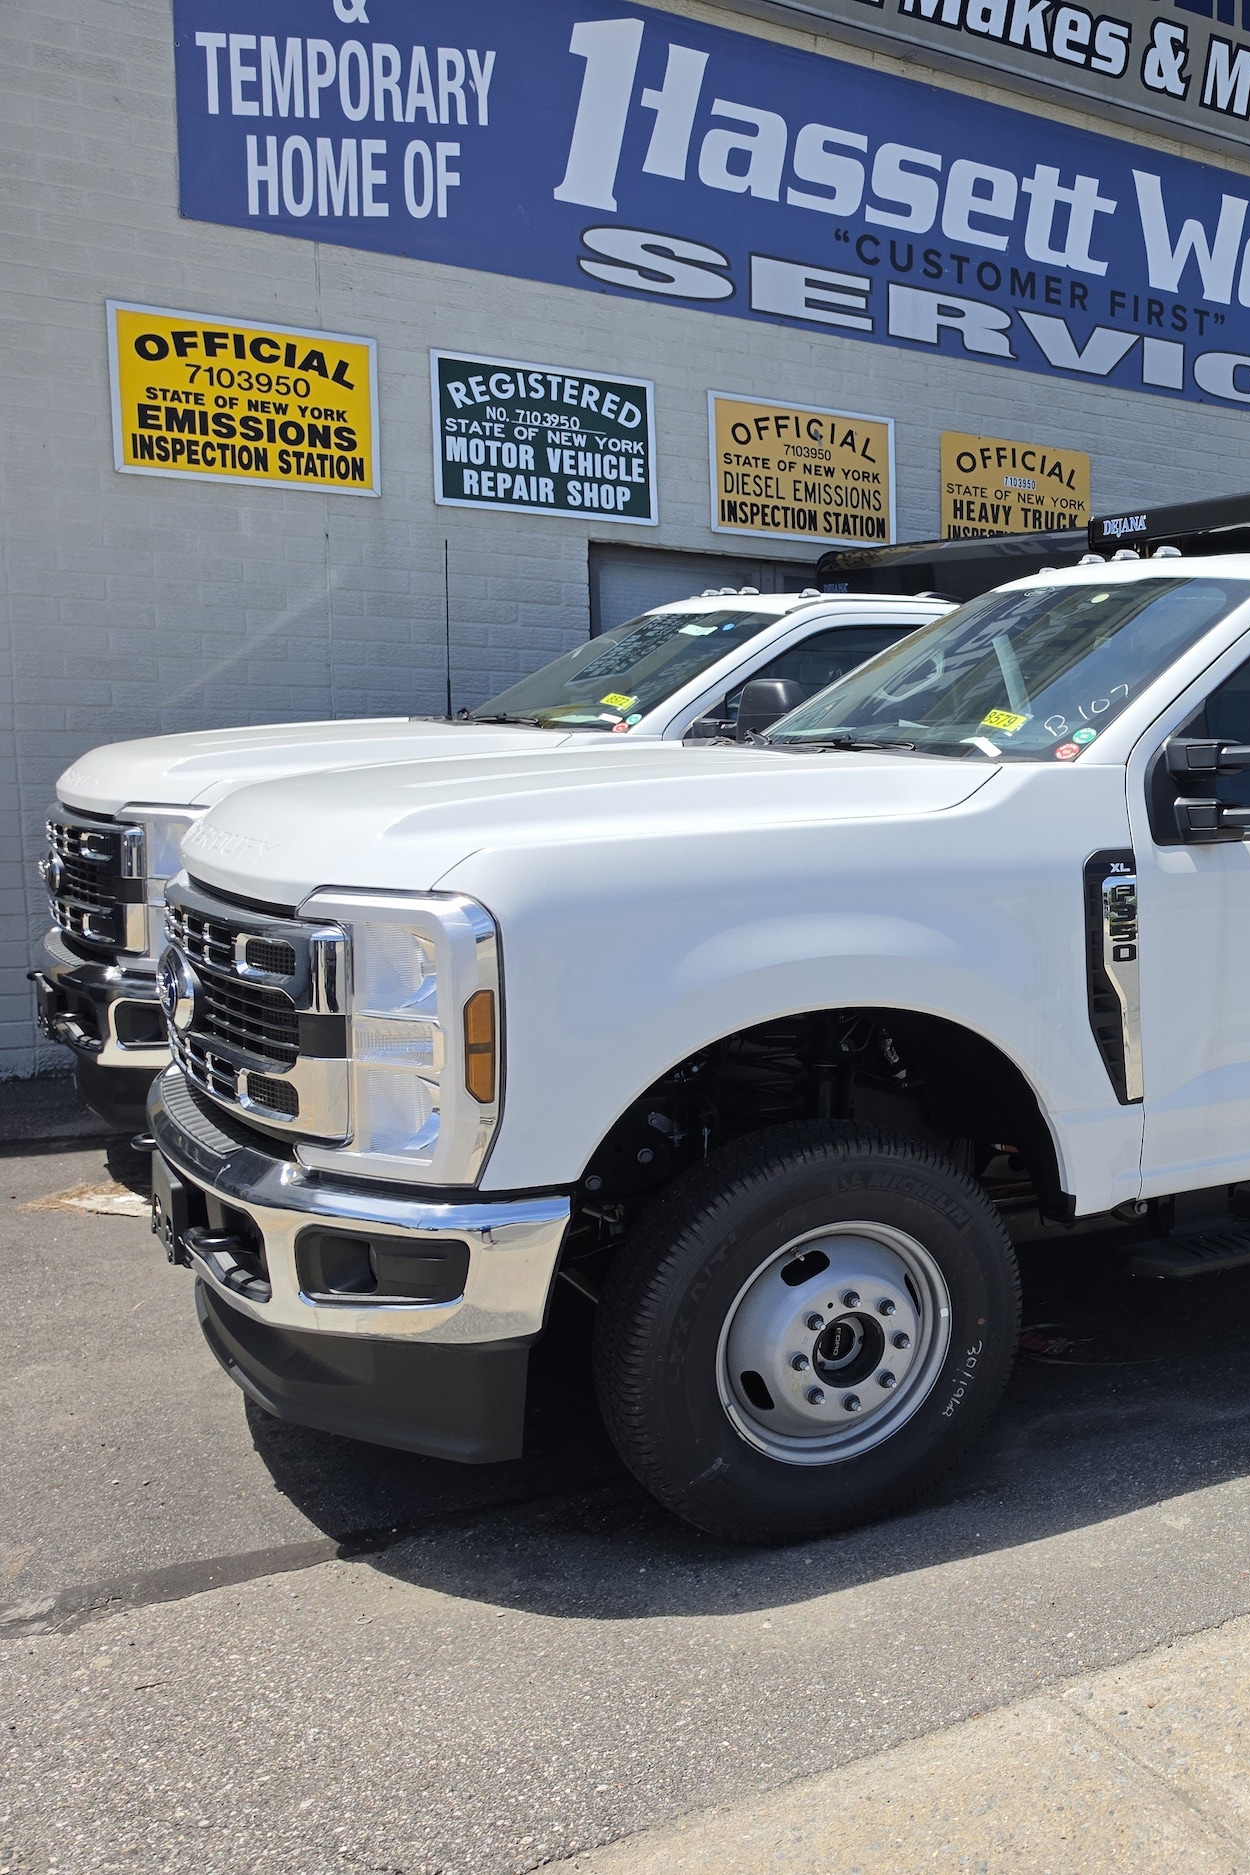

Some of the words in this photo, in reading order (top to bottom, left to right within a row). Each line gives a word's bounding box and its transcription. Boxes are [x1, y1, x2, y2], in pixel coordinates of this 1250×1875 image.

[195, 31, 497, 126] TEMPORARY
[1142, 19, 1190, 98] &
[246, 134, 389, 218] HOME
[404, 139, 461, 219] OF
[834, 229, 1089, 311] “CUSTOMER
[1110, 290, 1226, 336] FIRST”
[134, 331, 355, 390] OFFICIAL
[185, 363, 311, 398] 7103950
[145, 386, 205, 406] STATE
[214, 395, 239, 409] OF
[247, 399, 289, 415] NEW
[298, 405, 348, 423] YORK
[446, 372, 642, 429] REGISTERED
[486, 406, 510, 422] NO.
[515, 409, 581, 430] 7103950
[137, 403, 358, 452] EMISSIONS
[445, 417, 505, 438] STATE
[513, 426, 539, 441] OF
[547, 430, 587, 448] NEW
[595, 436, 645, 455] YORK
[731, 415, 876, 464] OFFICIAL
[131, 433, 269, 472] INSPECTION
[278, 449, 365, 482] STATION
[446, 435, 535, 471] MOTOR
[546, 447, 645, 483] VEHICLE
[723, 452, 771, 470] STATE
[777, 460, 797, 473] OF
[803, 463, 835, 478] NEW
[841, 468, 881, 484] YORK
[783, 444, 831, 461] 7103950
[956, 447, 1076, 491] OFFICIAL
[463, 468, 555, 504] REPAIR
[566, 480, 631, 511] SHOP
[724, 471, 786, 500] DIESEL
[793, 479, 882, 512] EMISSIONS
[946, 483, 988, 499] STATE
[994, 489, 1012, 501] OF
[1018, 492, 1045, 506] NEW
[1050, 496, 1086, 511] YORK
[1004, 476, 1036, 490] 7103950
[721, 499, 818, 531] INSPECTION
[823, 511, 886, 539] STATION
[953, 499, 1012, 526] HEAVY
[1021, 507, 1080, 530] TRUCK
[1103, 514, 1147, 538] DEJANA
[983, 711, 1018, 727] 8579
[1044, 714, 1069, 738] B
[1110, 862, 1131, 873] XL
[868, 1172, 972, 1225] MICHELIN
[832, 1327, 842, 1356] FORD
